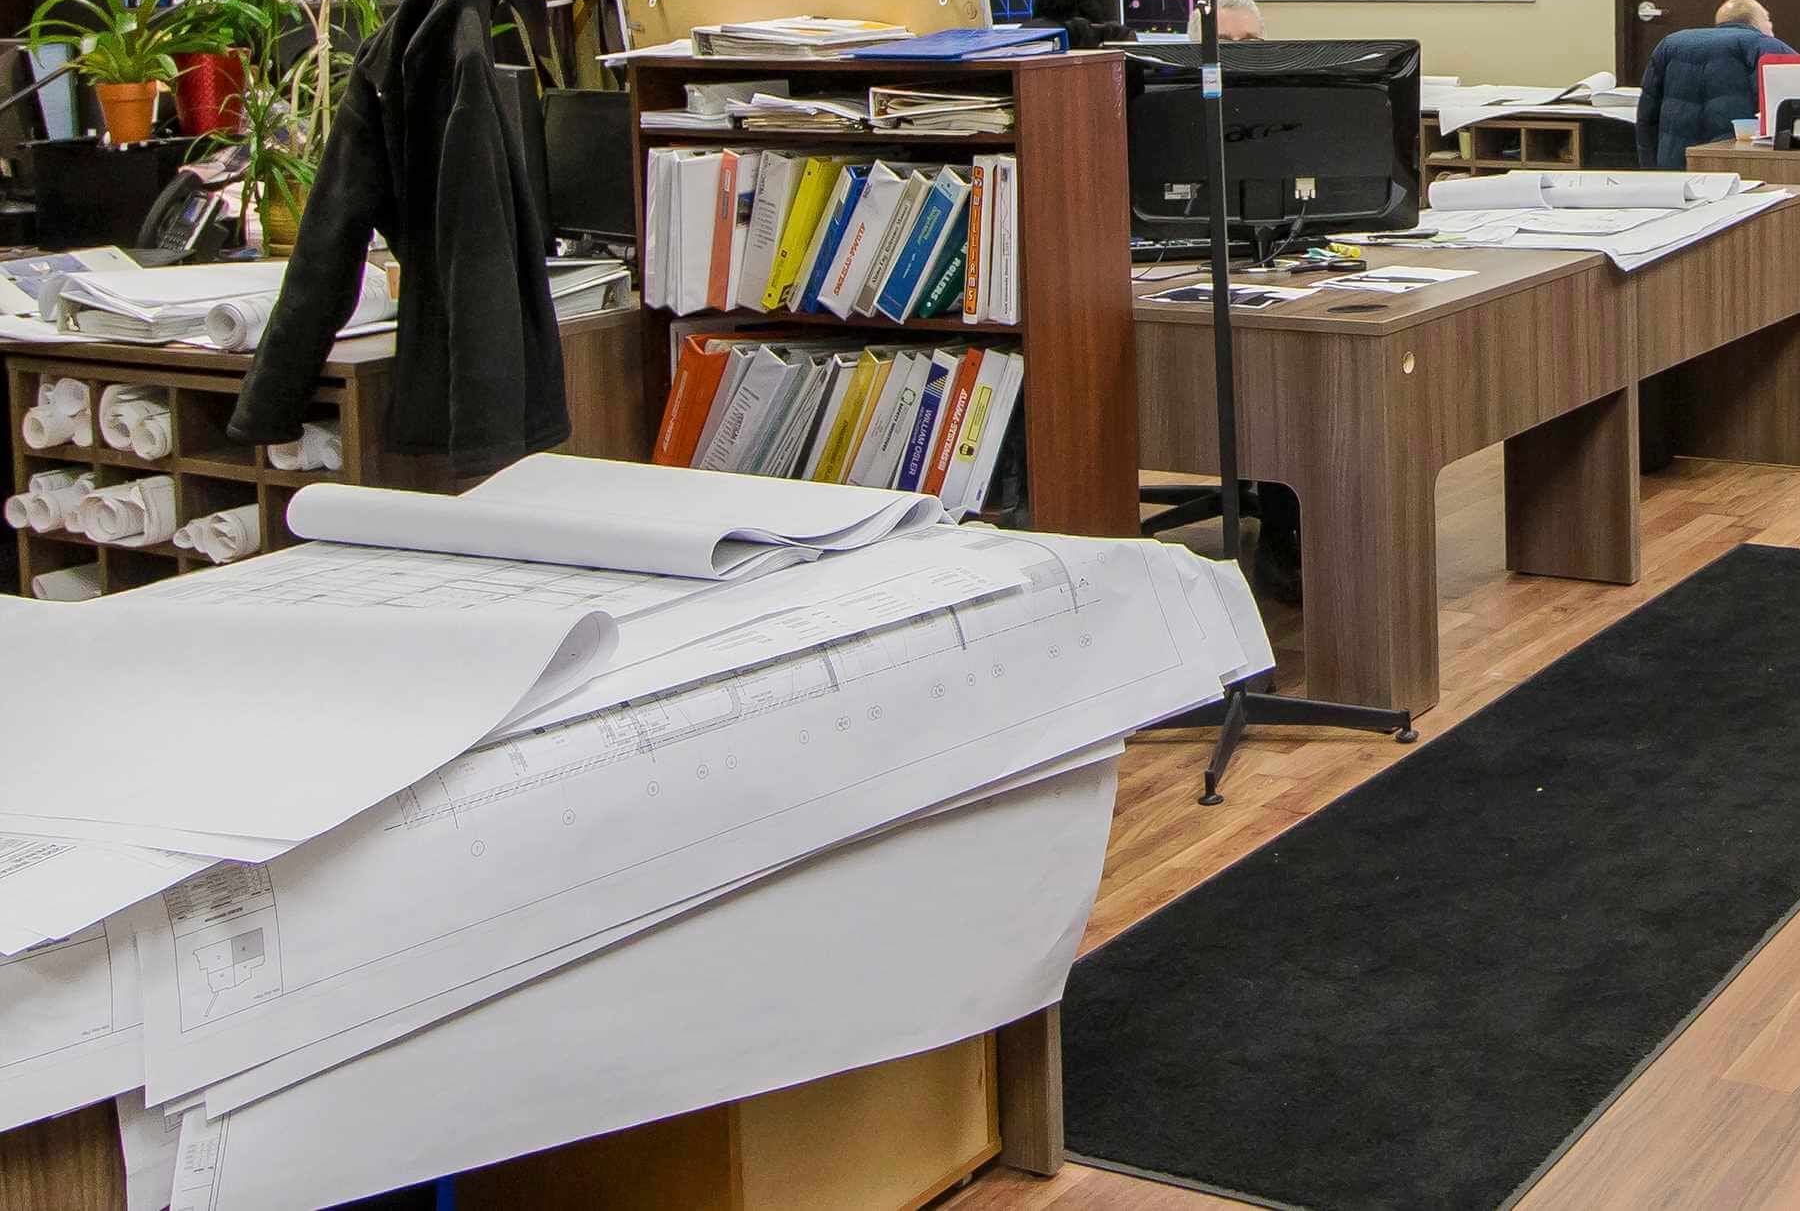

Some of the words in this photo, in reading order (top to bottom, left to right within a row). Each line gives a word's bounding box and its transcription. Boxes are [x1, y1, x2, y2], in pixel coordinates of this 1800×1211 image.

[931, 257, 961, 301] ROLLERS
[917, 409, 933, 446] WILLIAM
[910, 445, 923, 476] OSLER
